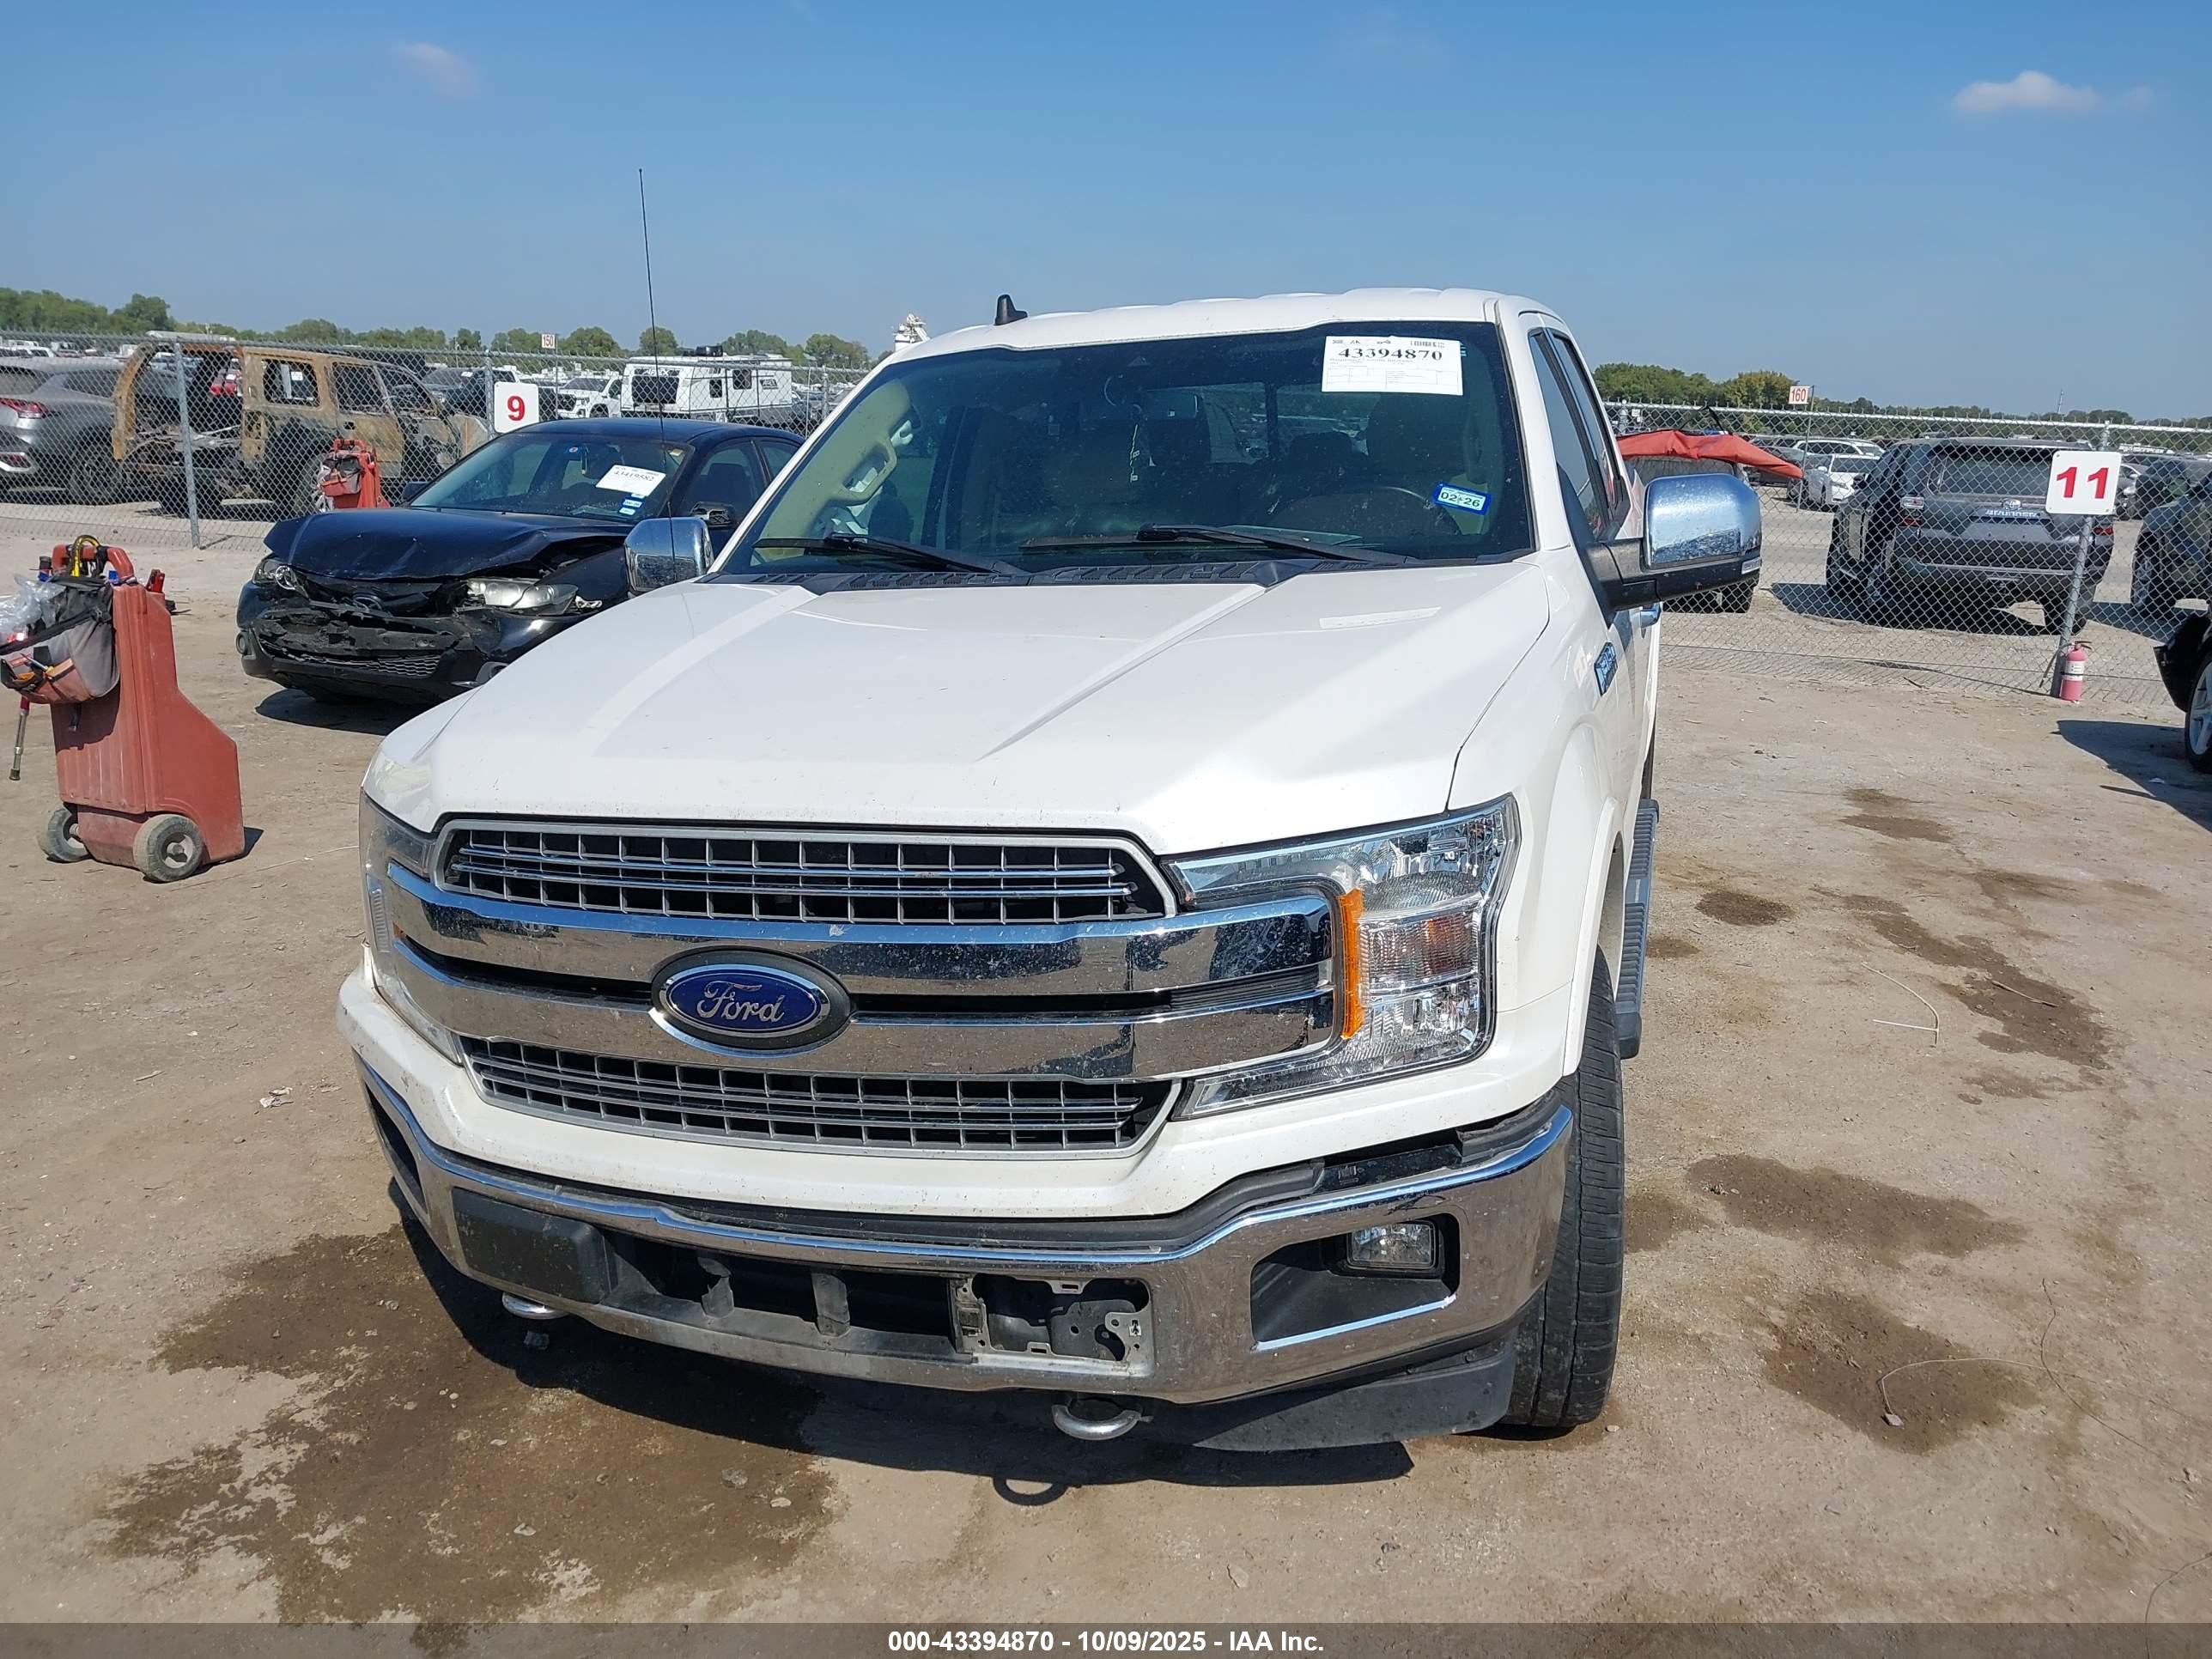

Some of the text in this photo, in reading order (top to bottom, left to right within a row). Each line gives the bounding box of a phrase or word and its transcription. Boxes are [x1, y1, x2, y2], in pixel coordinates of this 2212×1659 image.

[543, 335, 554, 347] 150
[1338, 347, 1443, 362] 43394870
[1791, 387, 1807, 403] 160
[507, 395, 526, 422] 9
[2056, 466, 2109, 499] 11
[696, 980, 785, 1023] Ford
